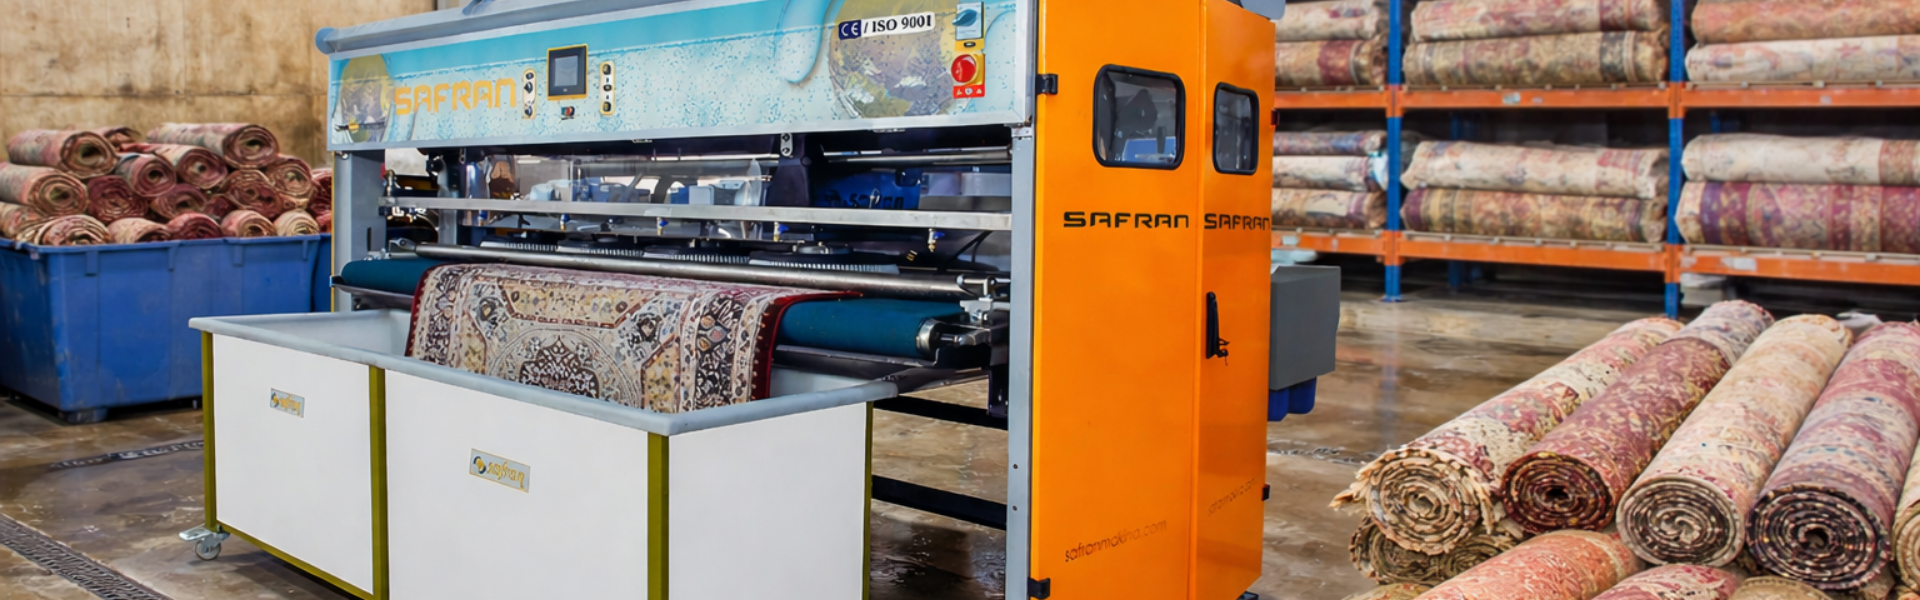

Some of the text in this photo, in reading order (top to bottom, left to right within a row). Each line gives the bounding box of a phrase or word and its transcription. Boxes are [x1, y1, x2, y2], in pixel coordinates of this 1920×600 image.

[872, 19, 898, 32] ISO
[901, 14, 932, 29] 9001
[394, 77, 517, 116] SAFRAN
[1063, 211, 1189, 229] SAFRAN
[1203, 213, 1271, 231] SAFRAN
